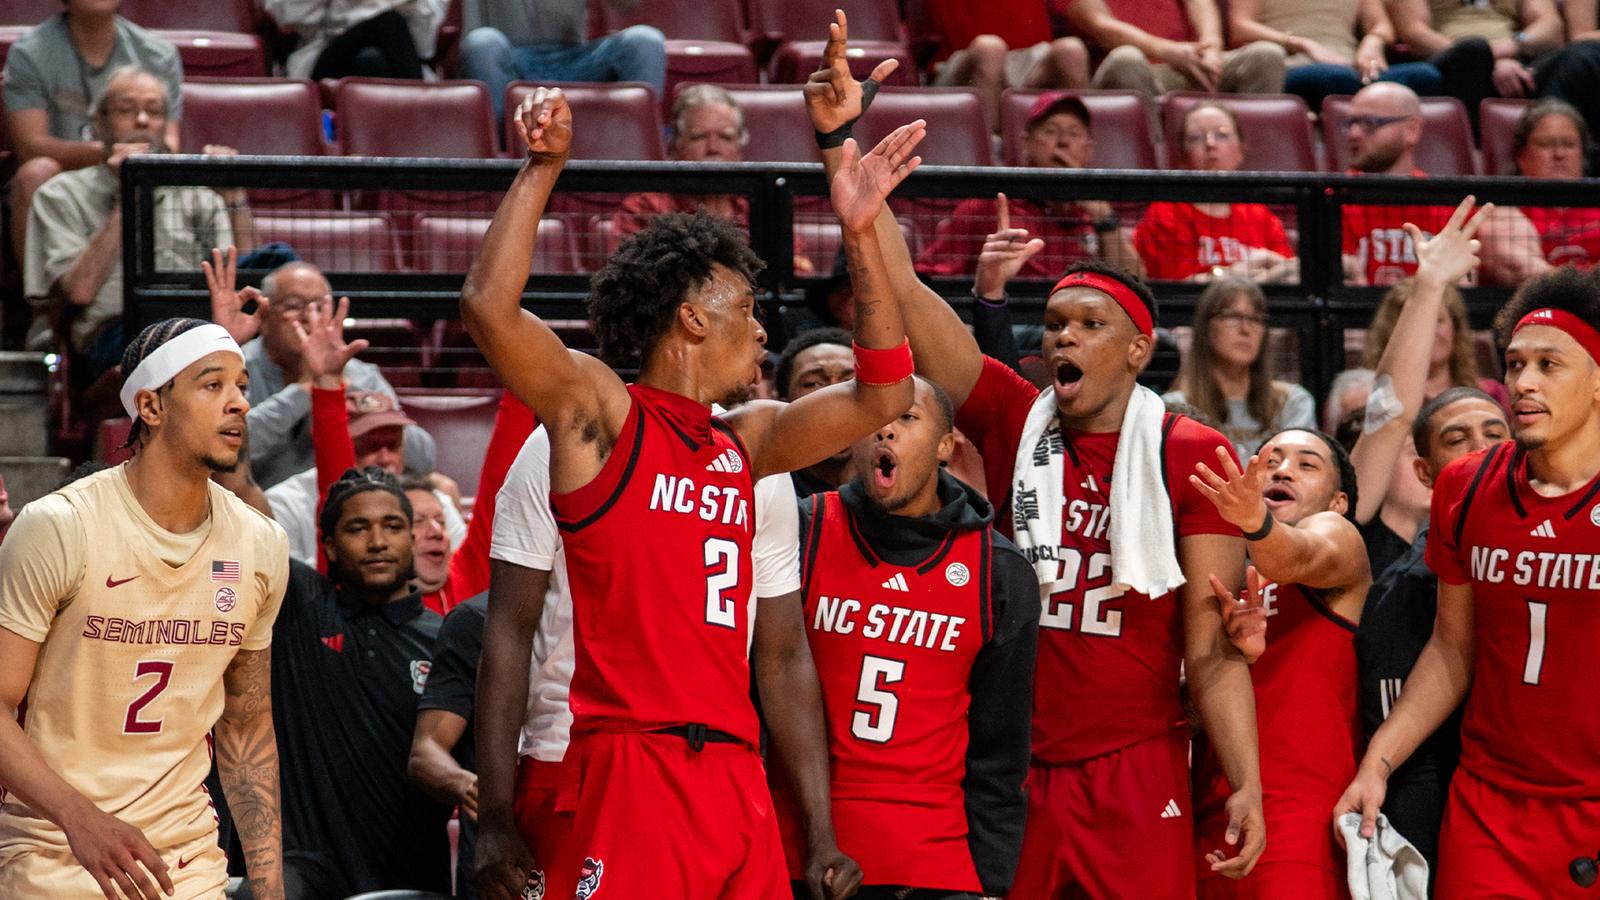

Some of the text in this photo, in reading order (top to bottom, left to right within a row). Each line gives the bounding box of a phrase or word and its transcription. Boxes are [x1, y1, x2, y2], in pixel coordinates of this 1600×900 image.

[649, 473, 695, 514] NC
[1022, 488, 1039, 520] MILK
[704, 536, 740, 630] 2
[1038, 546, 1123, 638] 22
[1470, 545, 1600, 591] NC STATE
[82, 615, 246, 647] SEMINOLES
[813, 595, 966, 652] NC STATE
[1521, 599, 1549, 687] 1
[122, 659, 177, 736] 2
[850, 653, 907, 745] 5
